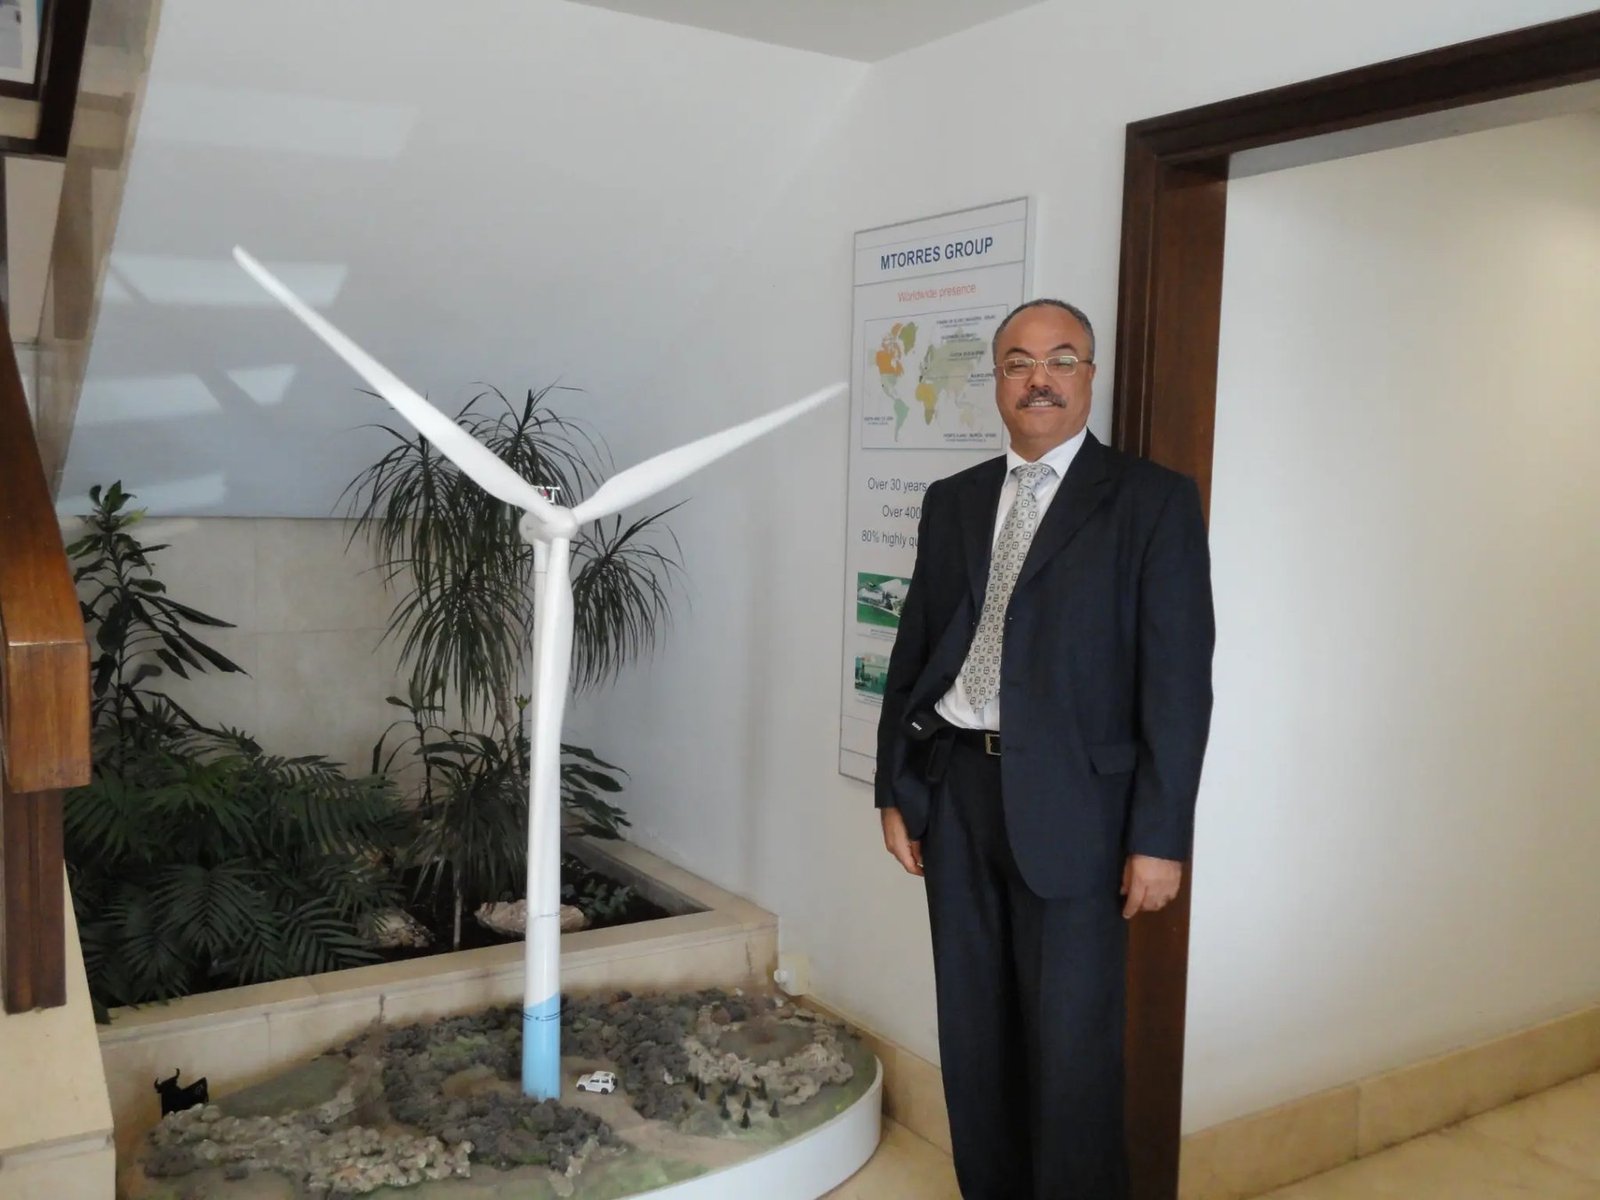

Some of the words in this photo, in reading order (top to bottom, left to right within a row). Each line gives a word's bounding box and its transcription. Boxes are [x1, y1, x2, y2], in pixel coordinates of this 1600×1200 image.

[881, 246, 940, 270] MTORRES
[944, 237, 993, 260] GROUP
[897, 288, 938, 302] Worldwide
[939, 284, 976, 301] presence
[868, 477, 888, 490] Over
[890, 478, 901, 491] 30
[903, 480, 927, 494] years
[882, 505, 903, 518] Over
[861, 530, 880, 543] 80%
[882, 532, 907, 549] highly
